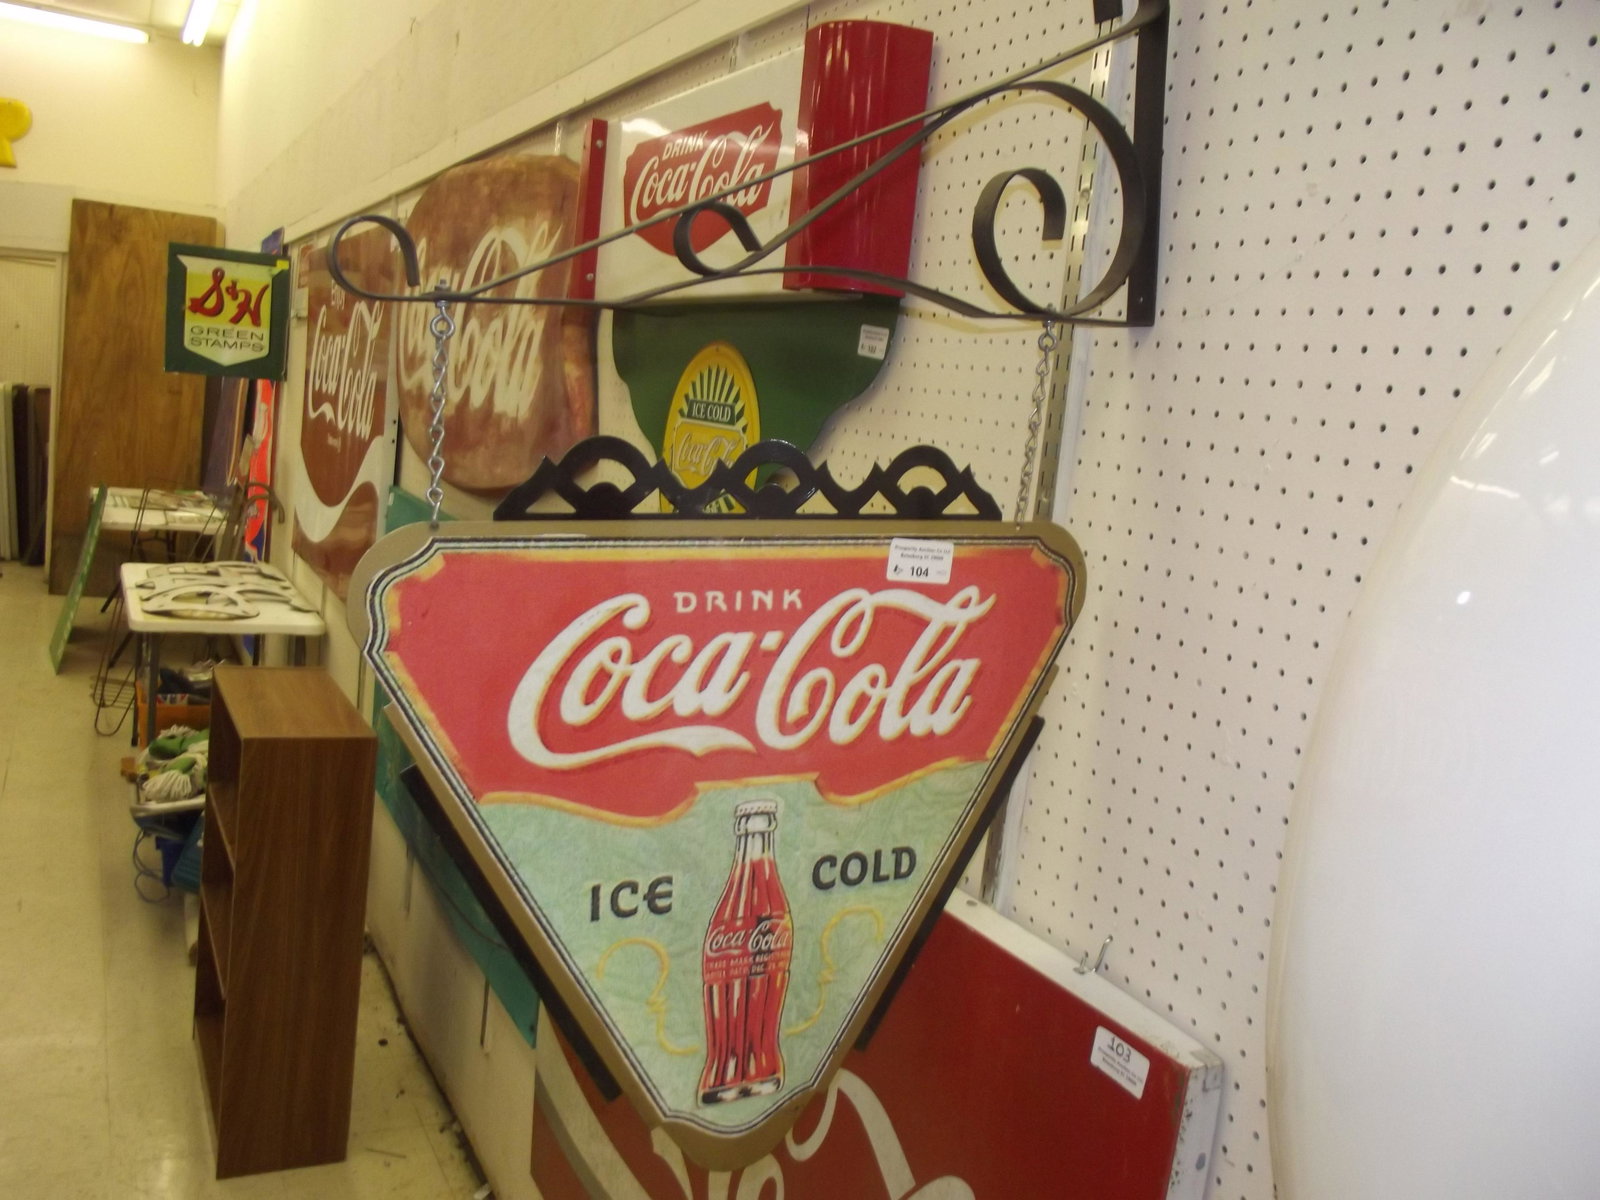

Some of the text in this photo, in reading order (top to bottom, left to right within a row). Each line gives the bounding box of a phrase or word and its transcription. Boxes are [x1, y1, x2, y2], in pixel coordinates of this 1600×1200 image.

[662, 130, 708, 161] DRINK
[190, 325, 265, 342] GREEN
[190, 336, 265, 353] STAMPS
[692, 401, 732, 423] ICE COLD
[910, 565, 930, 578] 104
[674, 588, 804, 614] DRINK
[507, 585, 997, 770] Coca-Cola
[589, 845, 917, 923] ICE COLD
[1107, 1036, 1132, 1064] 103
